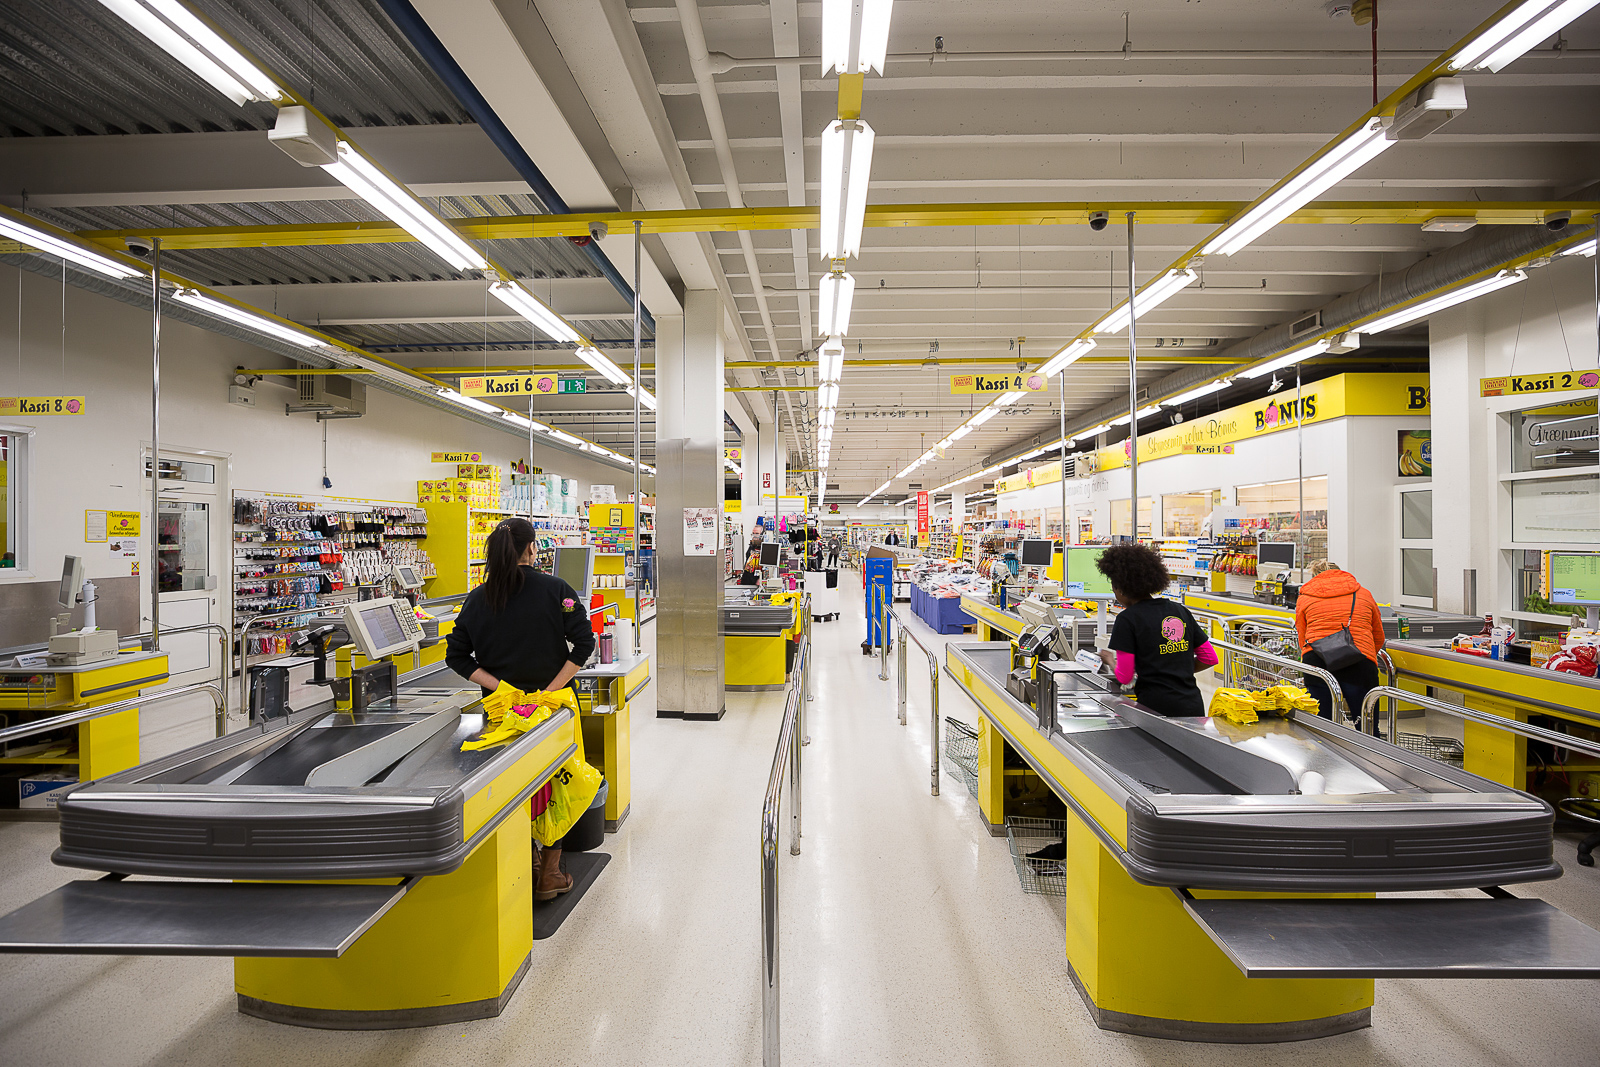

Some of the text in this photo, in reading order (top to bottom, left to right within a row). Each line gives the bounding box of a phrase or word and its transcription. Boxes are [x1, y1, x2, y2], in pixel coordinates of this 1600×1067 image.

[485, 379, 519, 393] Kassi
[525, 378, 533, 391] 6
[976, 376, 1008, 390] Kassi
[1013, 376, 1023, 389] 4
[1512, 376, 1554, 392] Kassi
[1562, 374, 1572, 388] 2
[20, 399, 49, 413] Kassi
[55, 399, 63, 412] 8
[1206, 419, 1237, 439] Bónus
[1196, 445, 1214, 453] Kassi
[444, 453, 462, 461] Kassi
